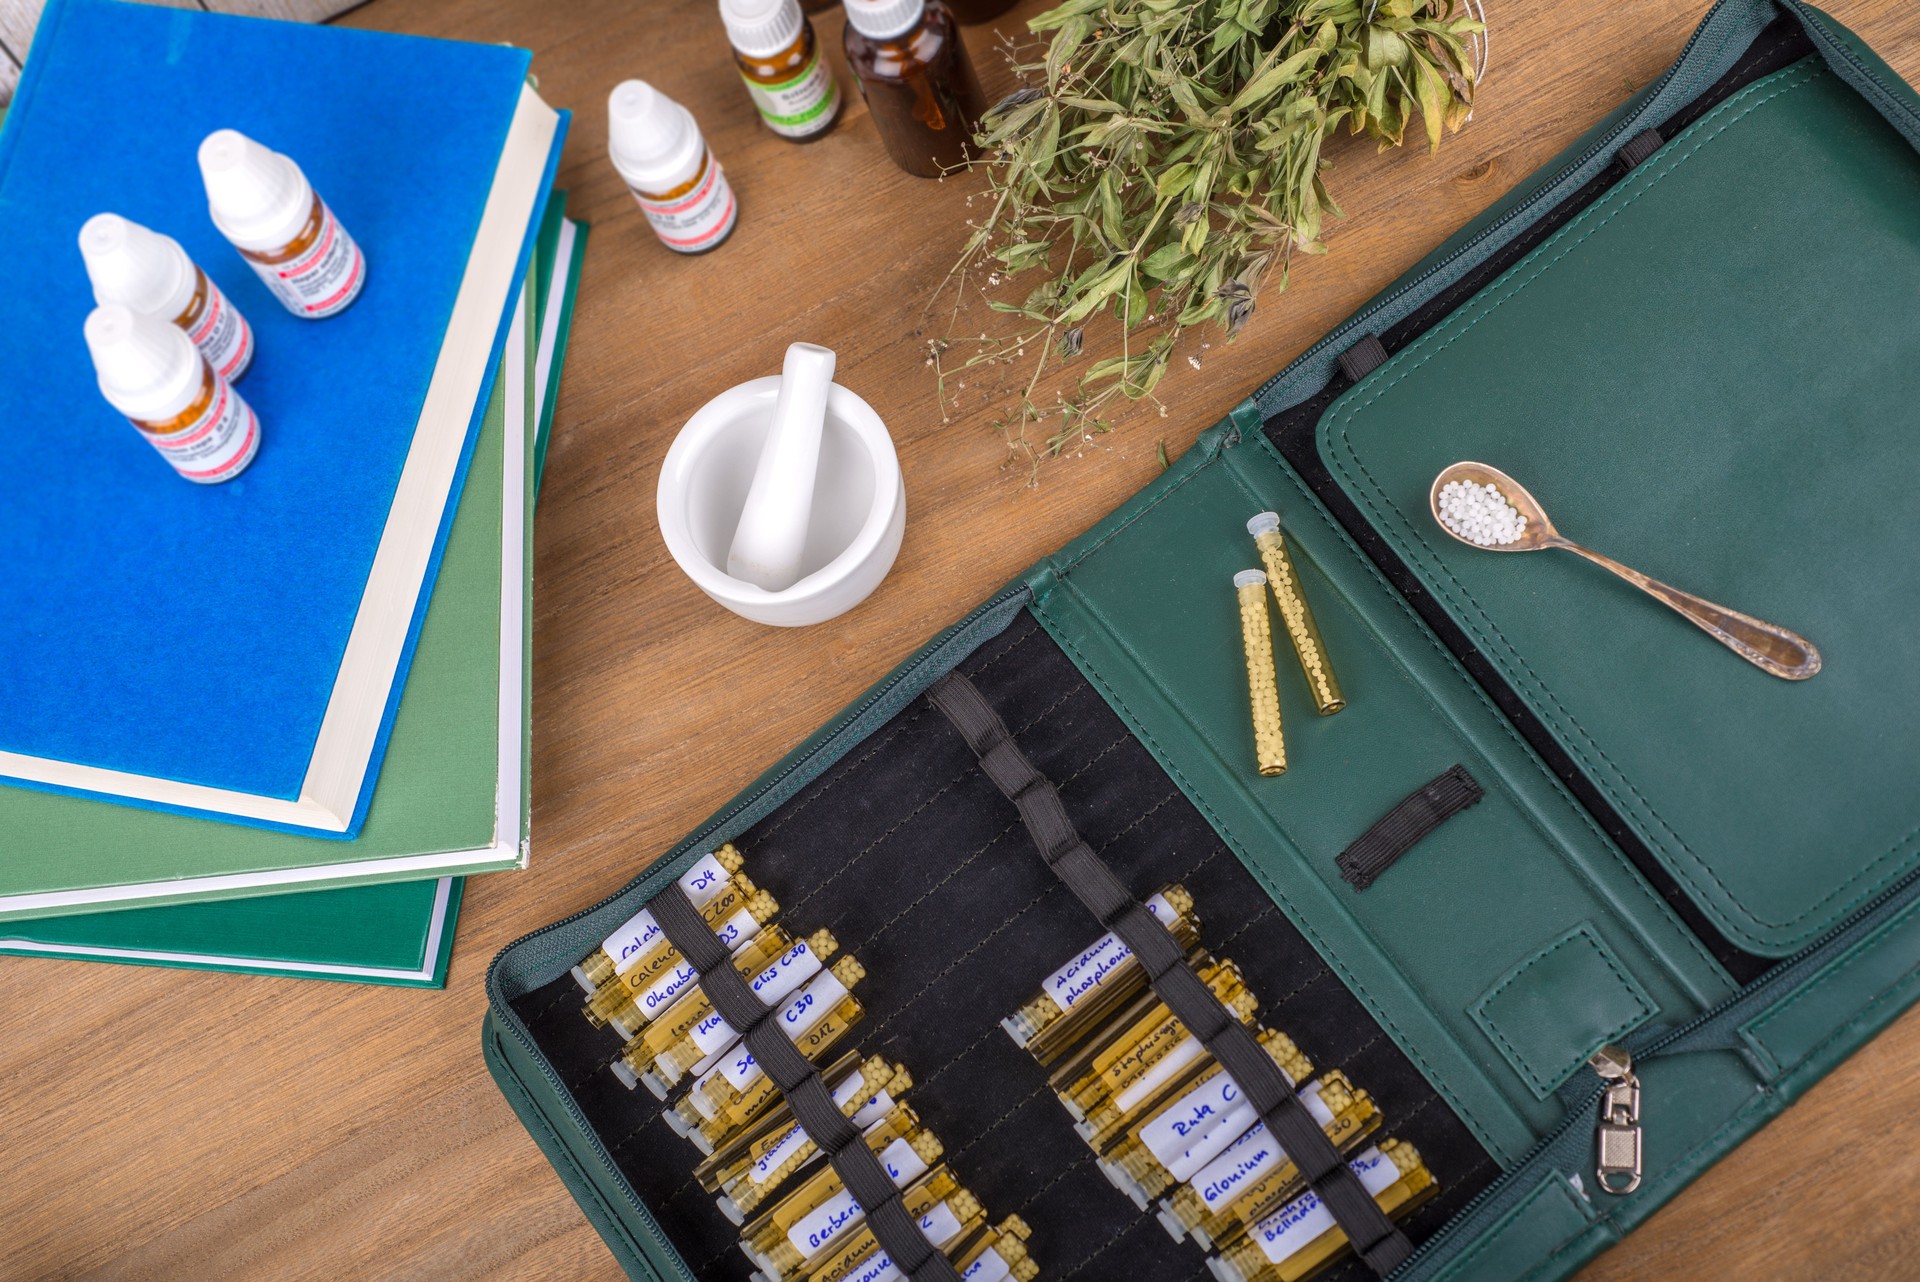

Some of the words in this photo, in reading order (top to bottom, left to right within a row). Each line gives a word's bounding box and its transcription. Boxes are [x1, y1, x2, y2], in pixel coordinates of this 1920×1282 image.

[622, 925, 660, 960] Colch
[690, 869, 716, 890] D4
[718, 924, 739, 945] D3
[781, 943, 806, 967] C30
[1057, 937, 1113, 989] Acidum
[1065, 946, 1132, 1005] phosphoric
[736, 1054, 756, 1075] Se
[785, 993, 814, 1023] C30
[1171, 1104, 1216, 1136] Ruta
[1330, 1117, 1351, 1138] 30
[1204, 1149, 1269, 1202] Glonium
[809, 1197, 860, 1248] Berberi
